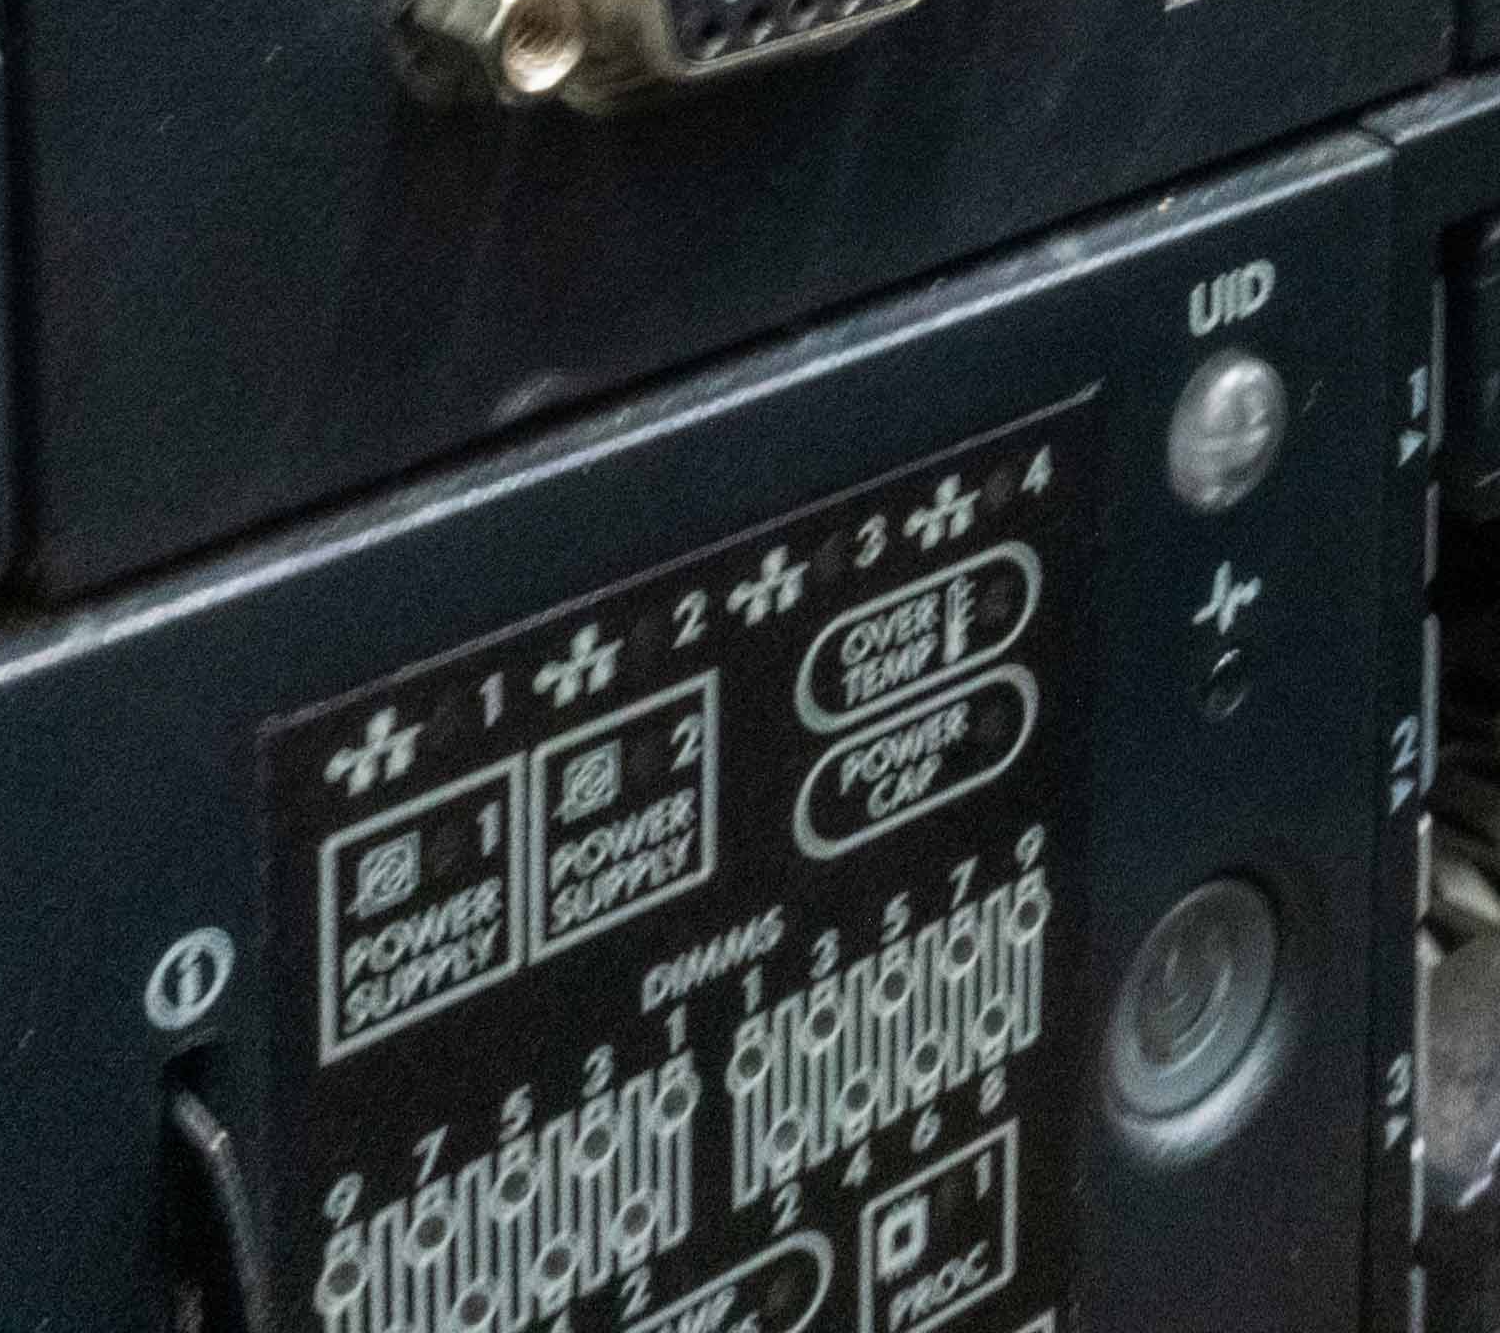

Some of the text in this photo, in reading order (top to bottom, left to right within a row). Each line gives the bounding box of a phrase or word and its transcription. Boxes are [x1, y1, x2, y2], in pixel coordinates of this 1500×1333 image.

[1187, 259, 1276, 337] UID
[1408, 365, 1427, 418] 1
[479, 445, 1052, 729] 1 2 3 4
[840, 592, 941, 667] OVER
[840, 633, 938, 709] TEMP
[671, 714, 701, 773] 2
[839, 700, 969, 796] POWER
[1391, 714, 1419, 771] 2
[477, 800, 500, 857] 1
[867, 752, 942, 820] CAP
[550, 788, 696, 891] POWER
[550, 827, 694, 934] SUPPLY
[343, 876, 502, 990] POWER
[642, 907, 784, 1013] DIMMS
[741, 823, 1046, 1013] 1 3 5 7 9
[345, 922, 500, 1034] SUPPLY
[324, 1004, 687, 1229] 9 7 5 3 1
[1386, 1052, 1413, 1105] 3
[772, 1065, 1007, 1234] 2 4 6 8
[974, 1150, 992, 1200] 1
[619, 1265, 652, 1322] 2
[887, 1239, 990, 1332] PROC
